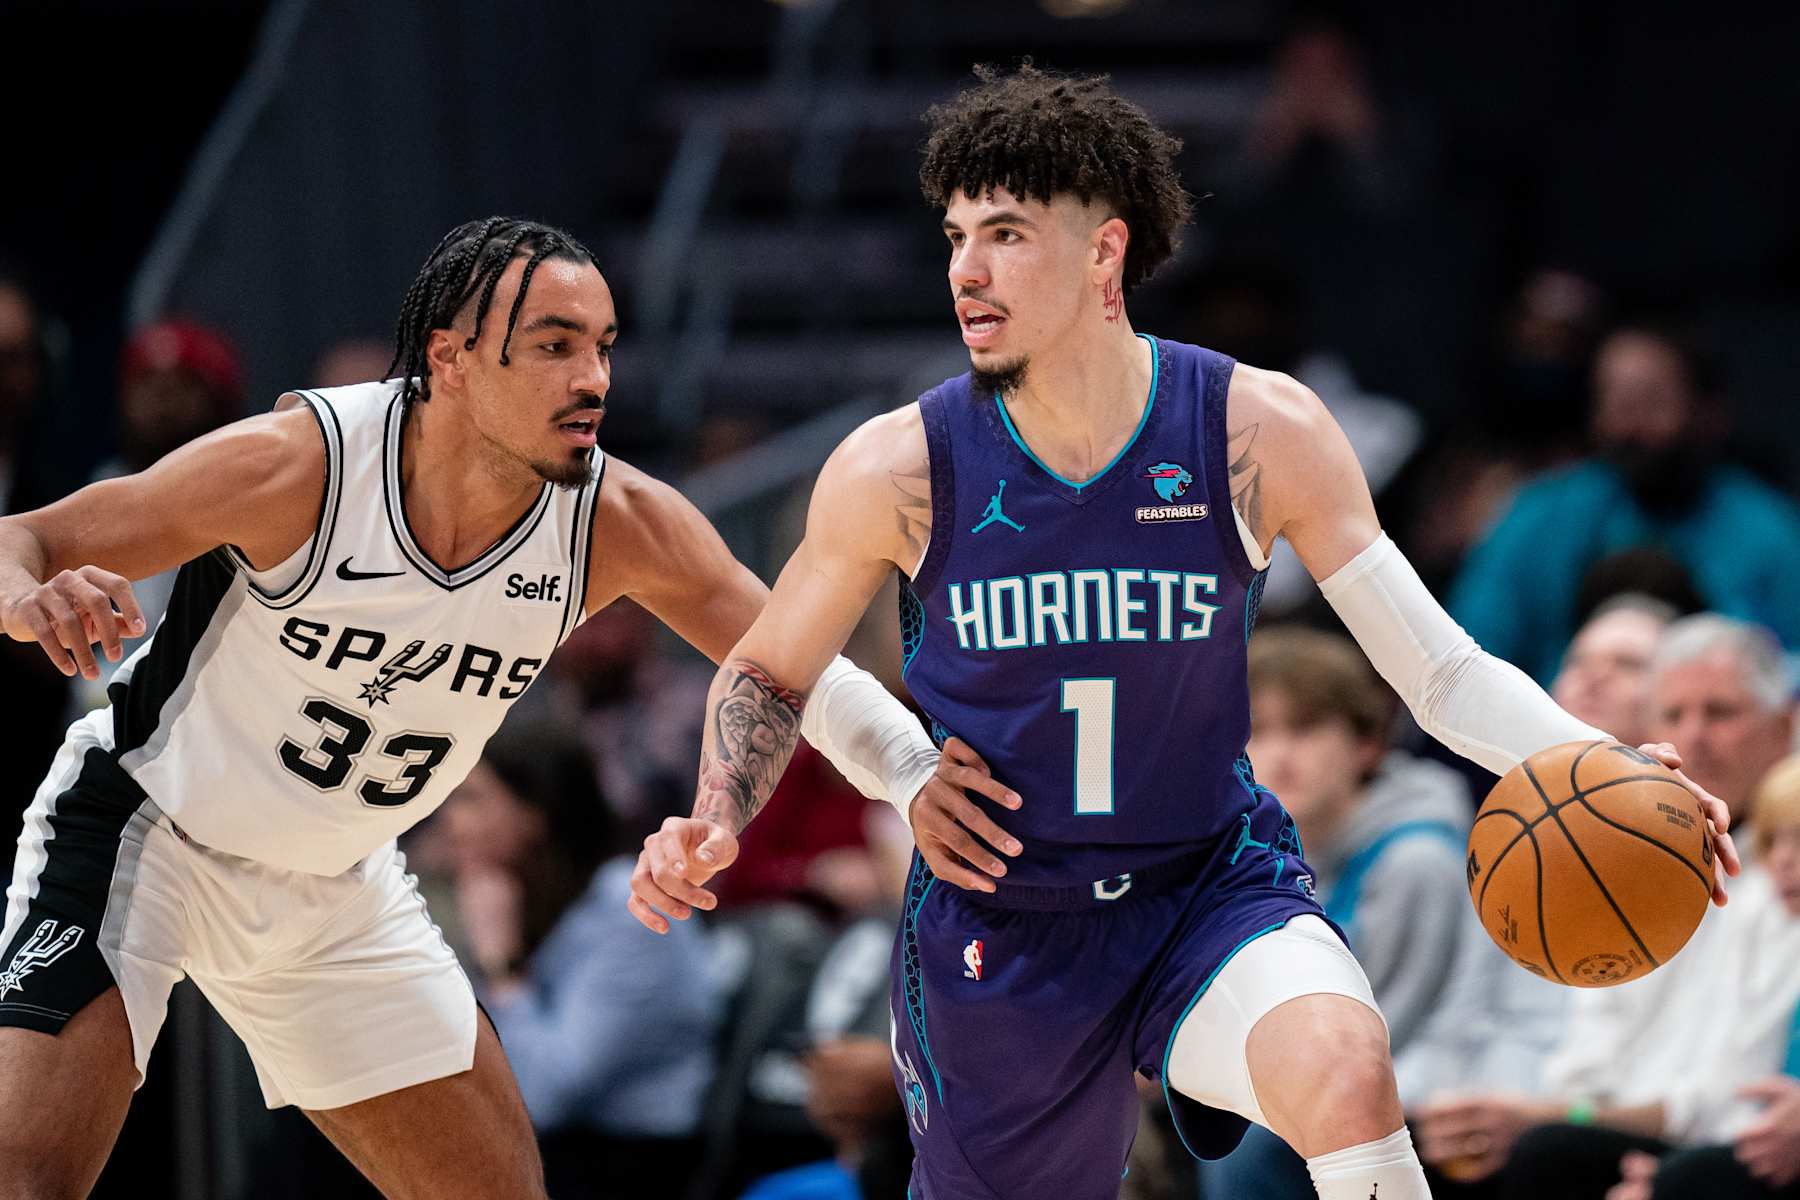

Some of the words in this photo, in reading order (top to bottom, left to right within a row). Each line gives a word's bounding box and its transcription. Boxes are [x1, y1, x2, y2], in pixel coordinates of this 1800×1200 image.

[1137, 505, 1206, 520] FEASTABLES
[505, 573, 562, 602] Self.
[946, 568, 1222, 650] HORNETS
[279, 616, 542, 705] SPURS
[275, 695, 457, 809] 33
[1060, 677, 1116, 815] 1
